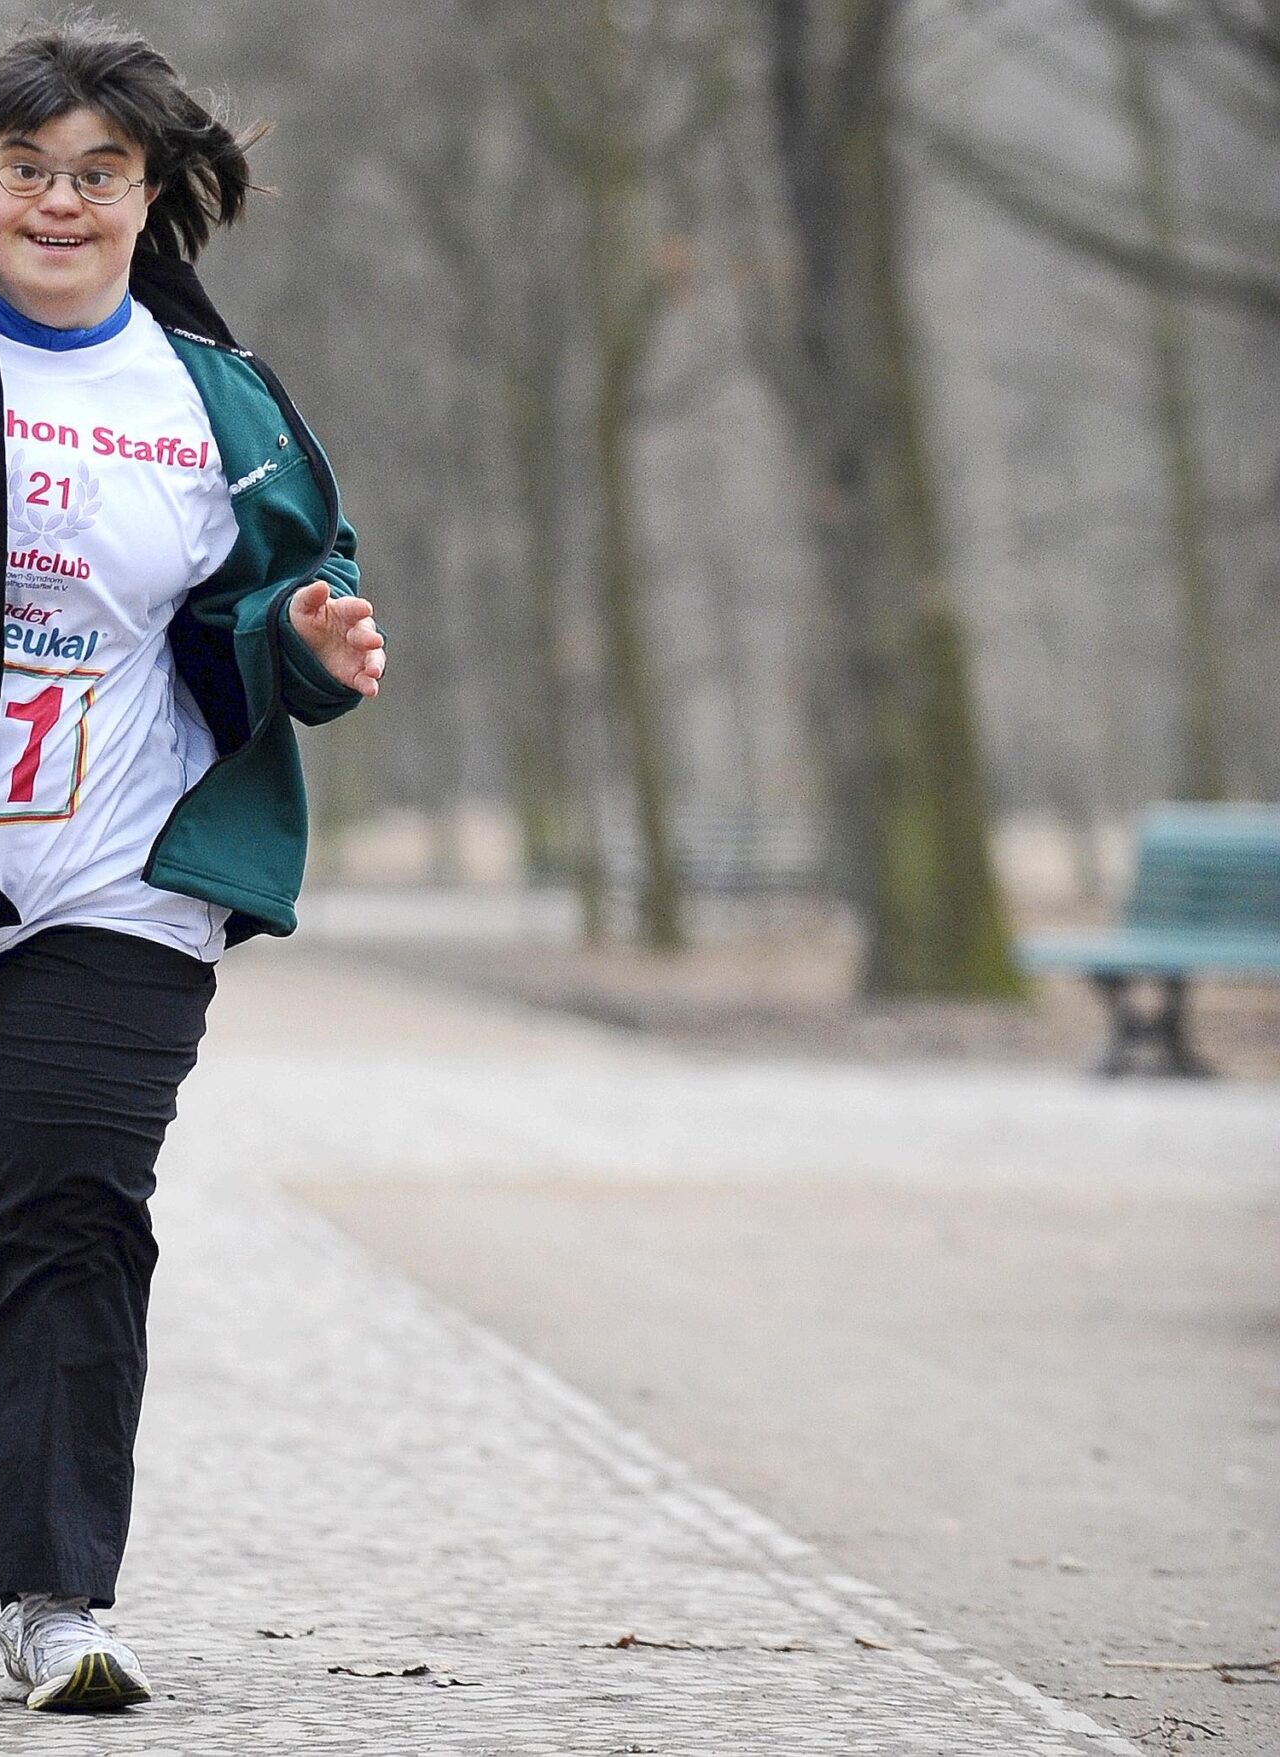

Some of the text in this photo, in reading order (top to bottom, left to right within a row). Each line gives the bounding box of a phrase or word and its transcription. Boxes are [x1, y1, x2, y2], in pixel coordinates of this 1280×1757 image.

[6, 409, 209, 469] hon Staffel
[26, 471, 71, 510] 21
[7, 549, 90, 580] ufclub
[5, 685, 64, 803] 1
